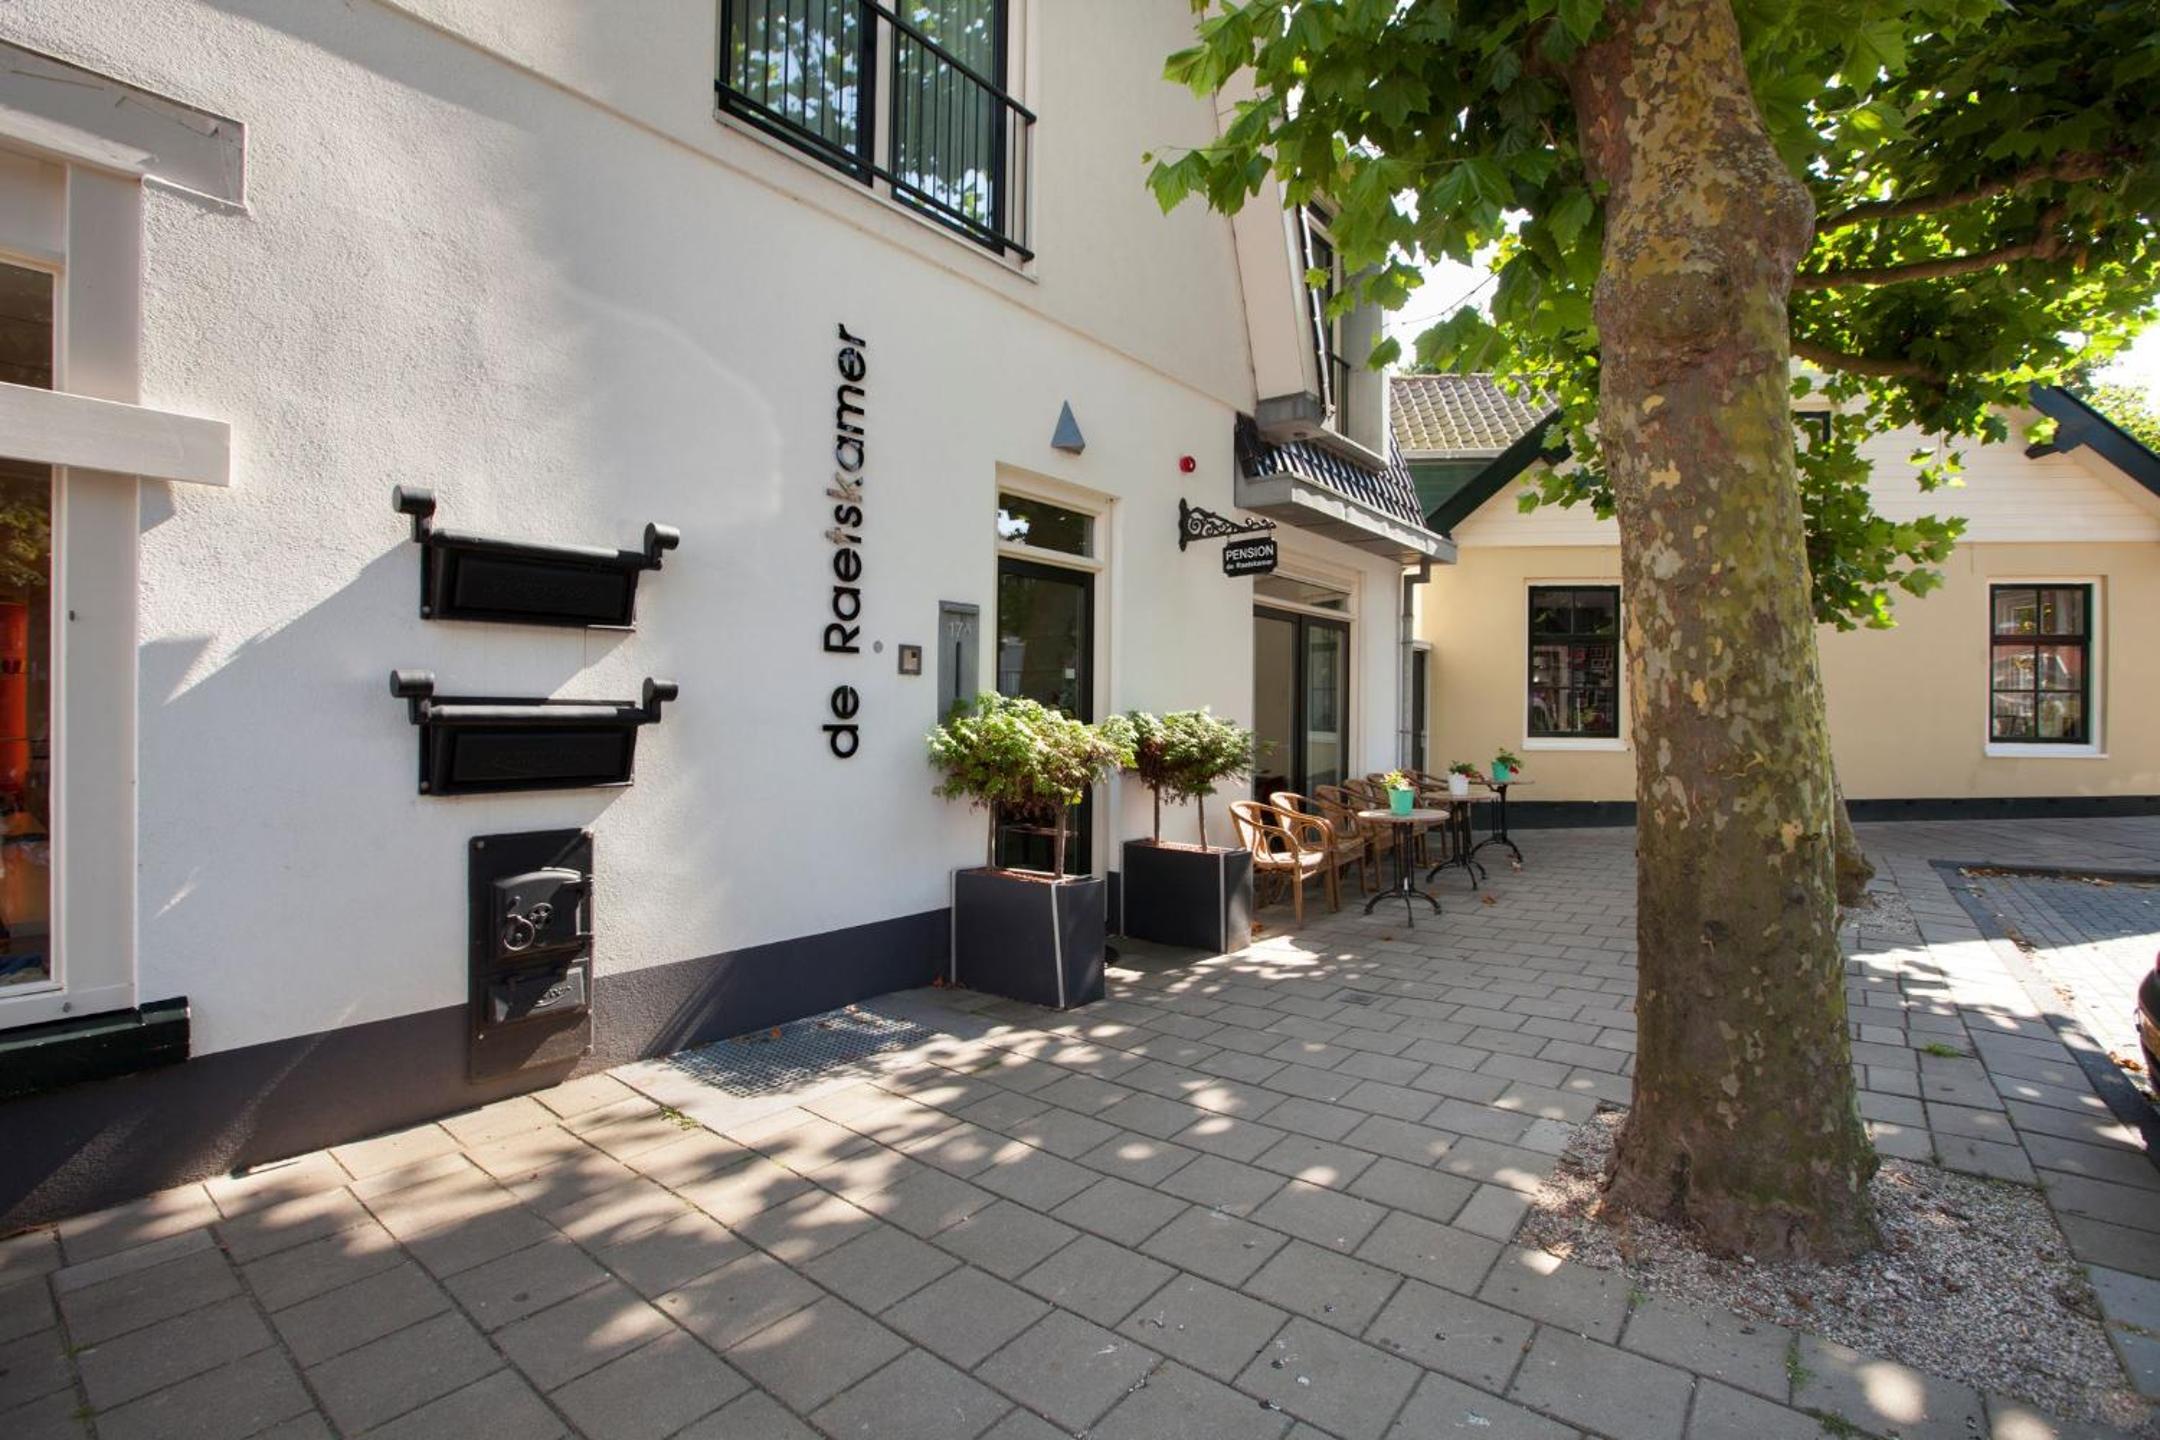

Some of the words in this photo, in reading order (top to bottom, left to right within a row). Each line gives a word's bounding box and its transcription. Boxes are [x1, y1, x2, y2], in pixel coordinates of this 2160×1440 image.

[823, 322, 867, 654] Raetskamer
[1225, 544, 1274, 561] PENSION
[822, 684, 861, 759] de
